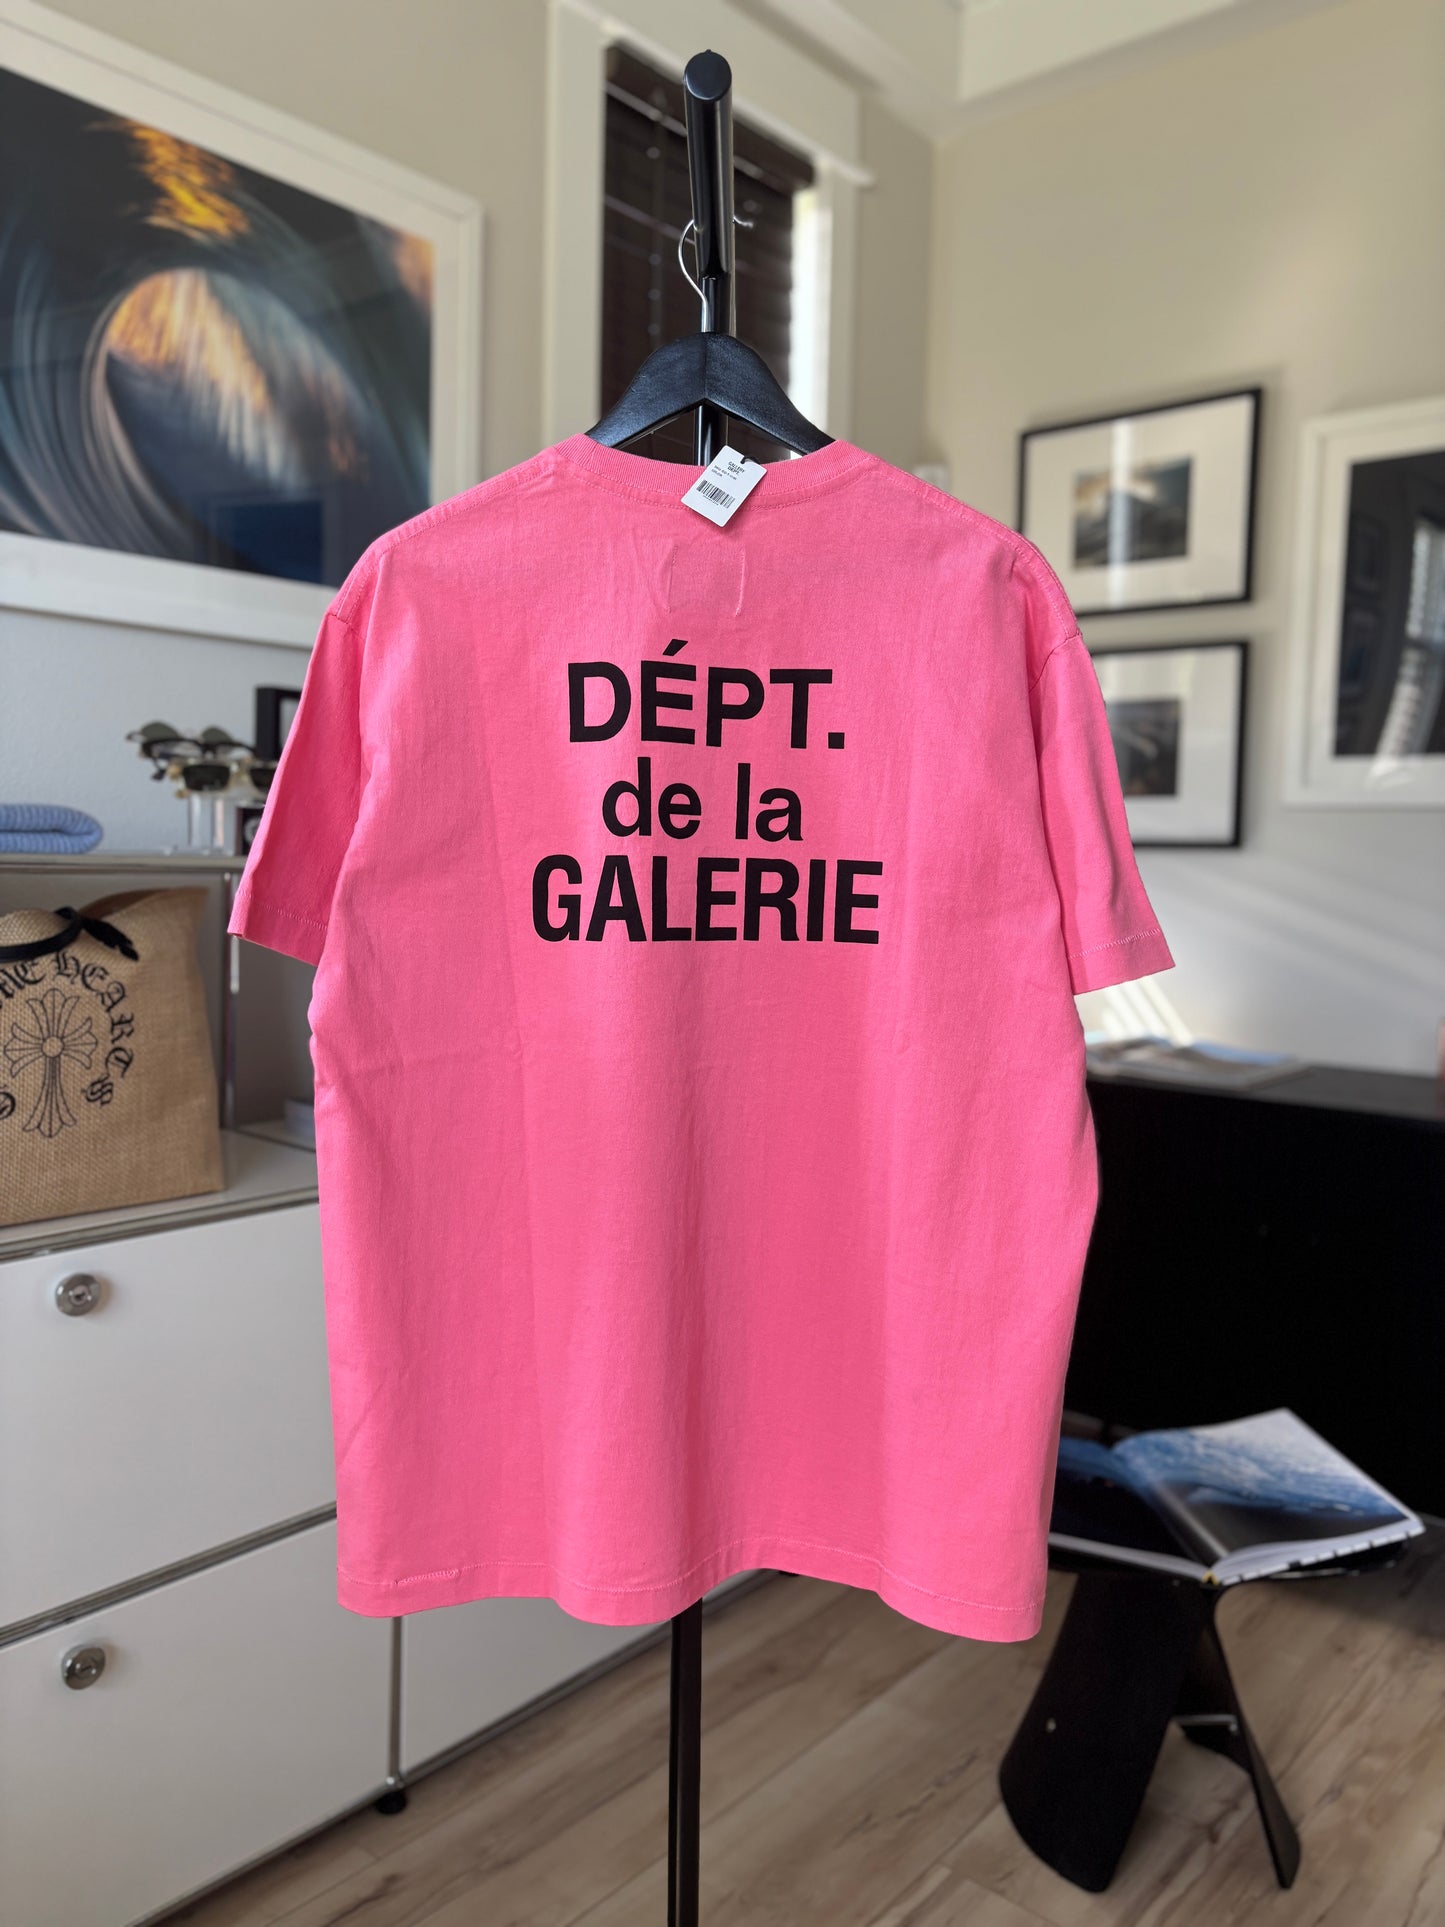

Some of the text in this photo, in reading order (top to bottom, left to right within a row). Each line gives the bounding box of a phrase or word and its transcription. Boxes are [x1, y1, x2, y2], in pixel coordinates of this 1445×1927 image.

[568, 639, 845, 749] DÉPT.
[602, 757, 803, 842] de la
[532, 854, 883, 944] GALERIE
[53, 952, 135, 1107] HEARTS
